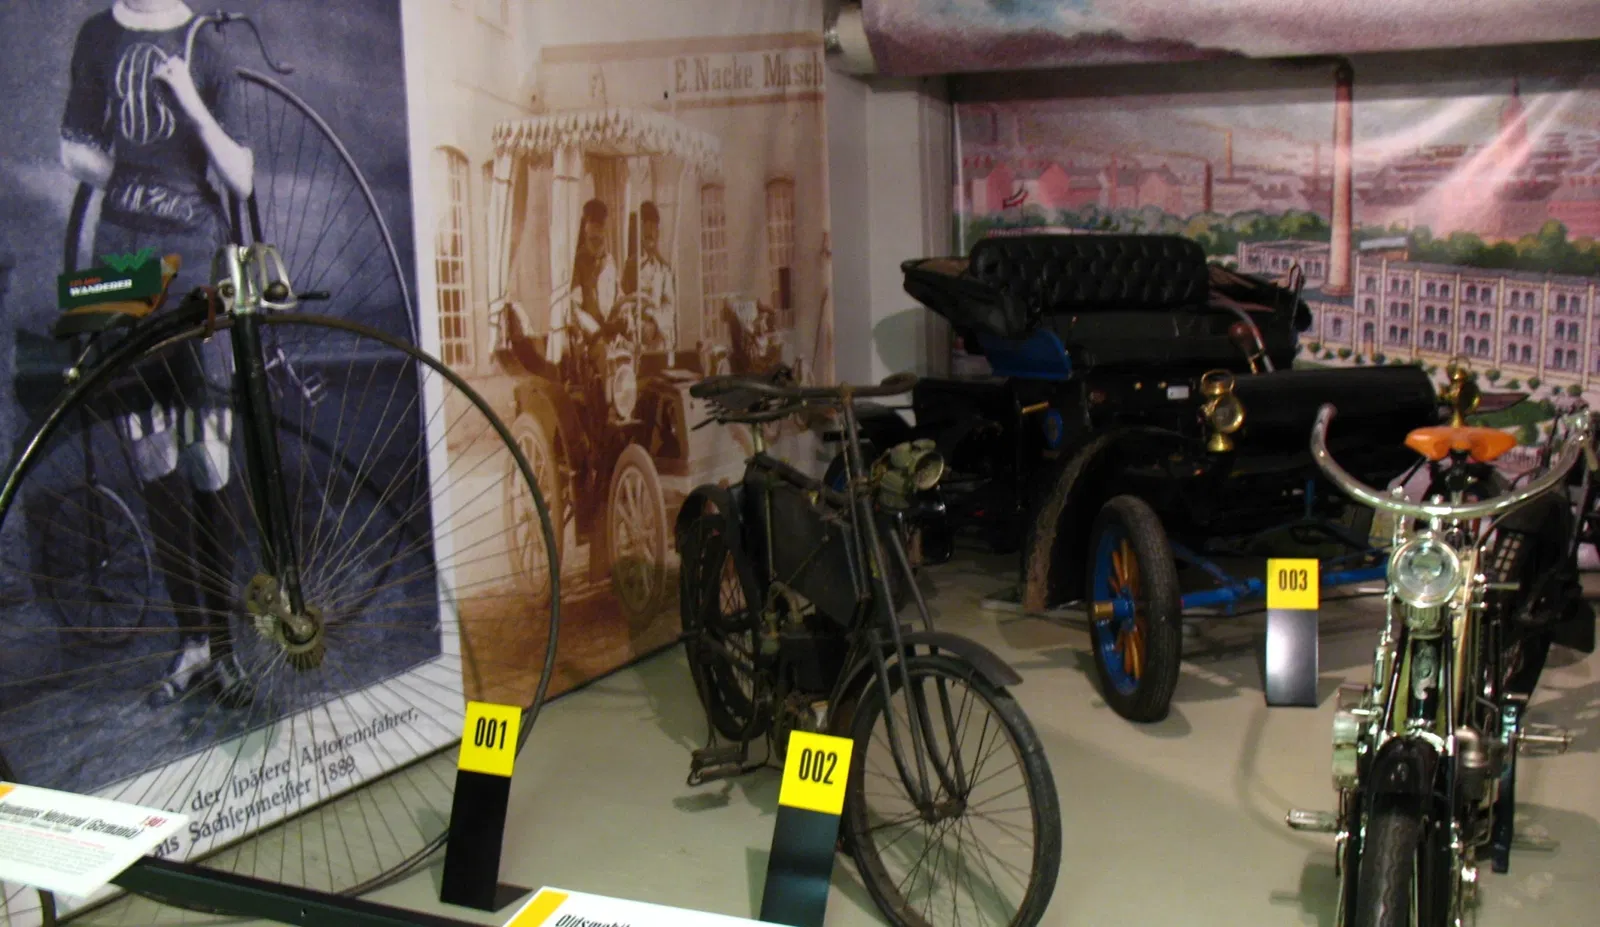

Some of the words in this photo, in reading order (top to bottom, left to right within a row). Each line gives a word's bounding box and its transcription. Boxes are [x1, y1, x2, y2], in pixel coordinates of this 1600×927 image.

[70, 278, 133, 297] WANDERER
[1278, 568, 1308, 591] 003
[474, 716, 508, 751] 001
[798, 747, 838, 785] 002
[154, 834, 180, 859] als
[320, 755, 356, 786] 1889
[191, 787, 222, 812] der
